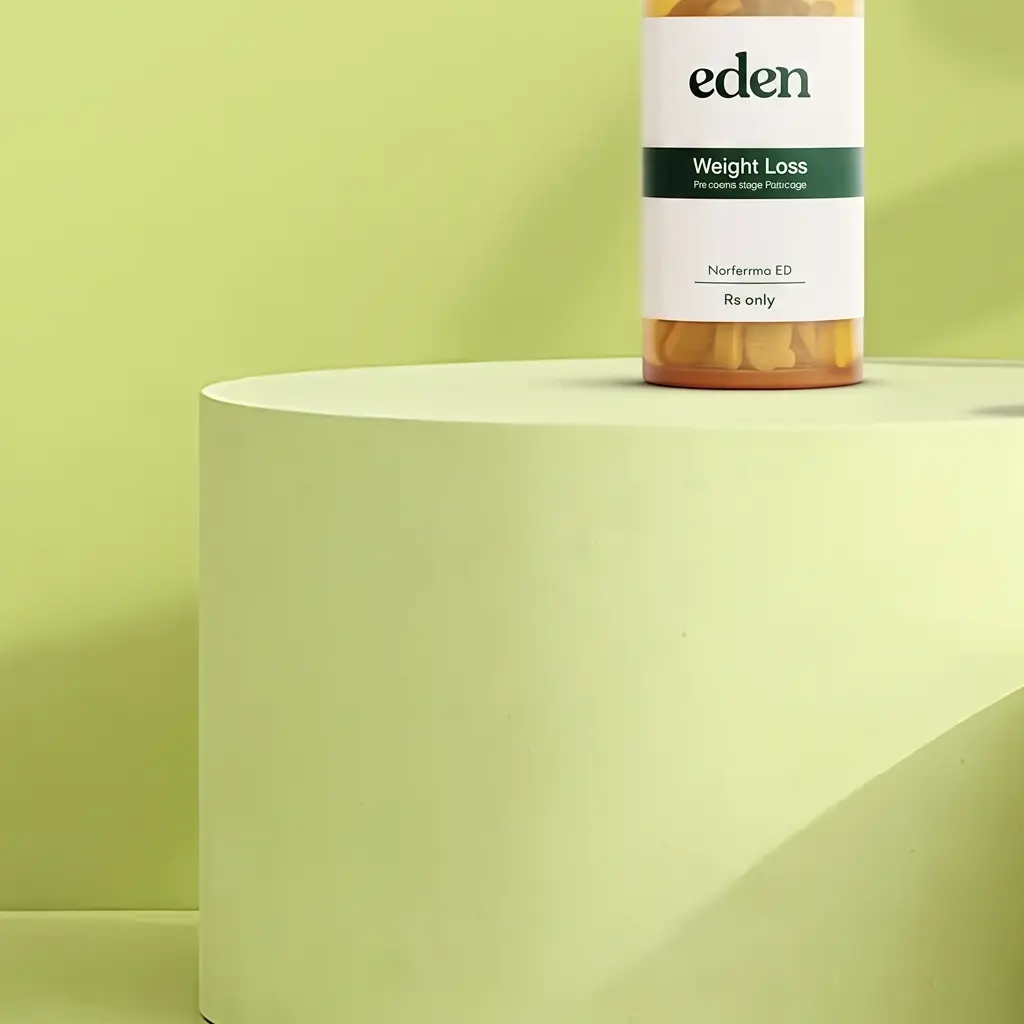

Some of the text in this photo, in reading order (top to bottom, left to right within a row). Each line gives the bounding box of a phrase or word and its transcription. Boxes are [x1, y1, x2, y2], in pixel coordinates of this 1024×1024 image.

[689, 51, 811, 98] eden
[693, 157, 808, 179] Weight Loss
[775, 265, 792, 276] ED
[724, 293, 776, 310] Rs only
